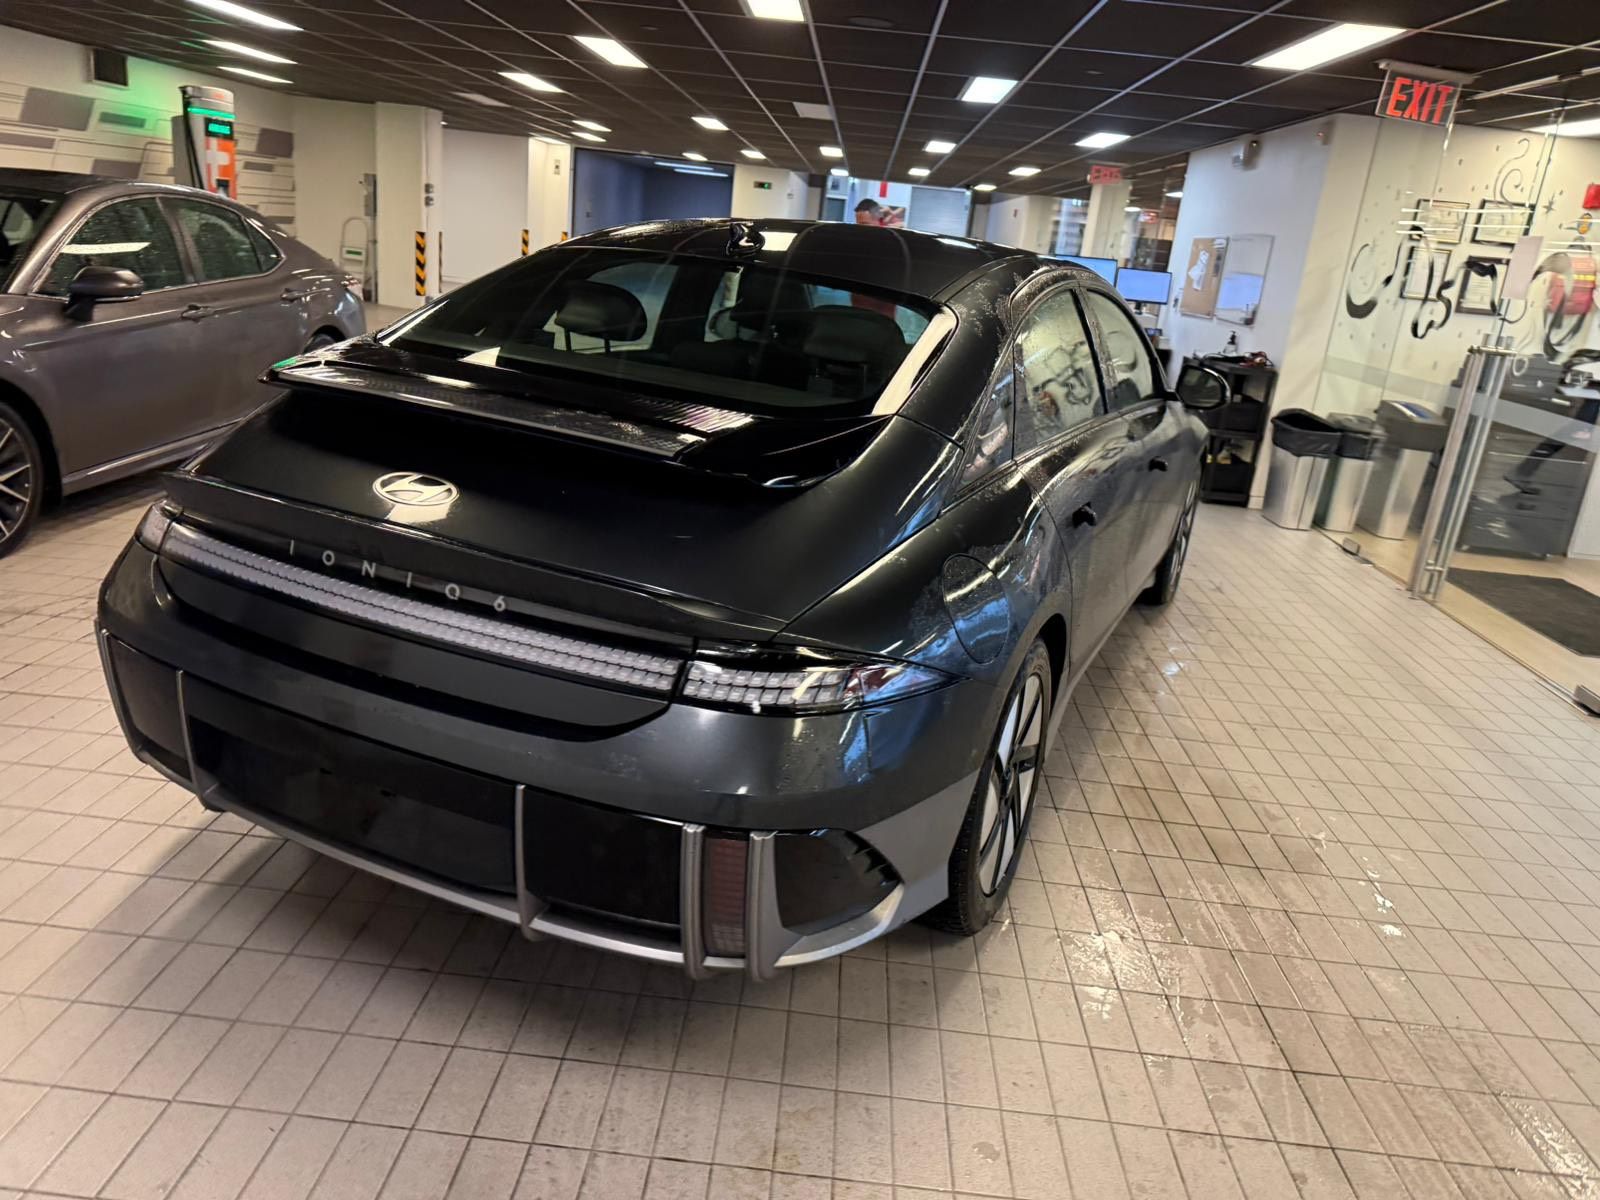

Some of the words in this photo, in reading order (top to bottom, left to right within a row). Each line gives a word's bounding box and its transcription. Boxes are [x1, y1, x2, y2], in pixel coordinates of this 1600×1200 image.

[1385, 76, 1456, 124] EXIT
[289, 538, 461, 601] IONIQ
[493, 595, 507, 612] 6
